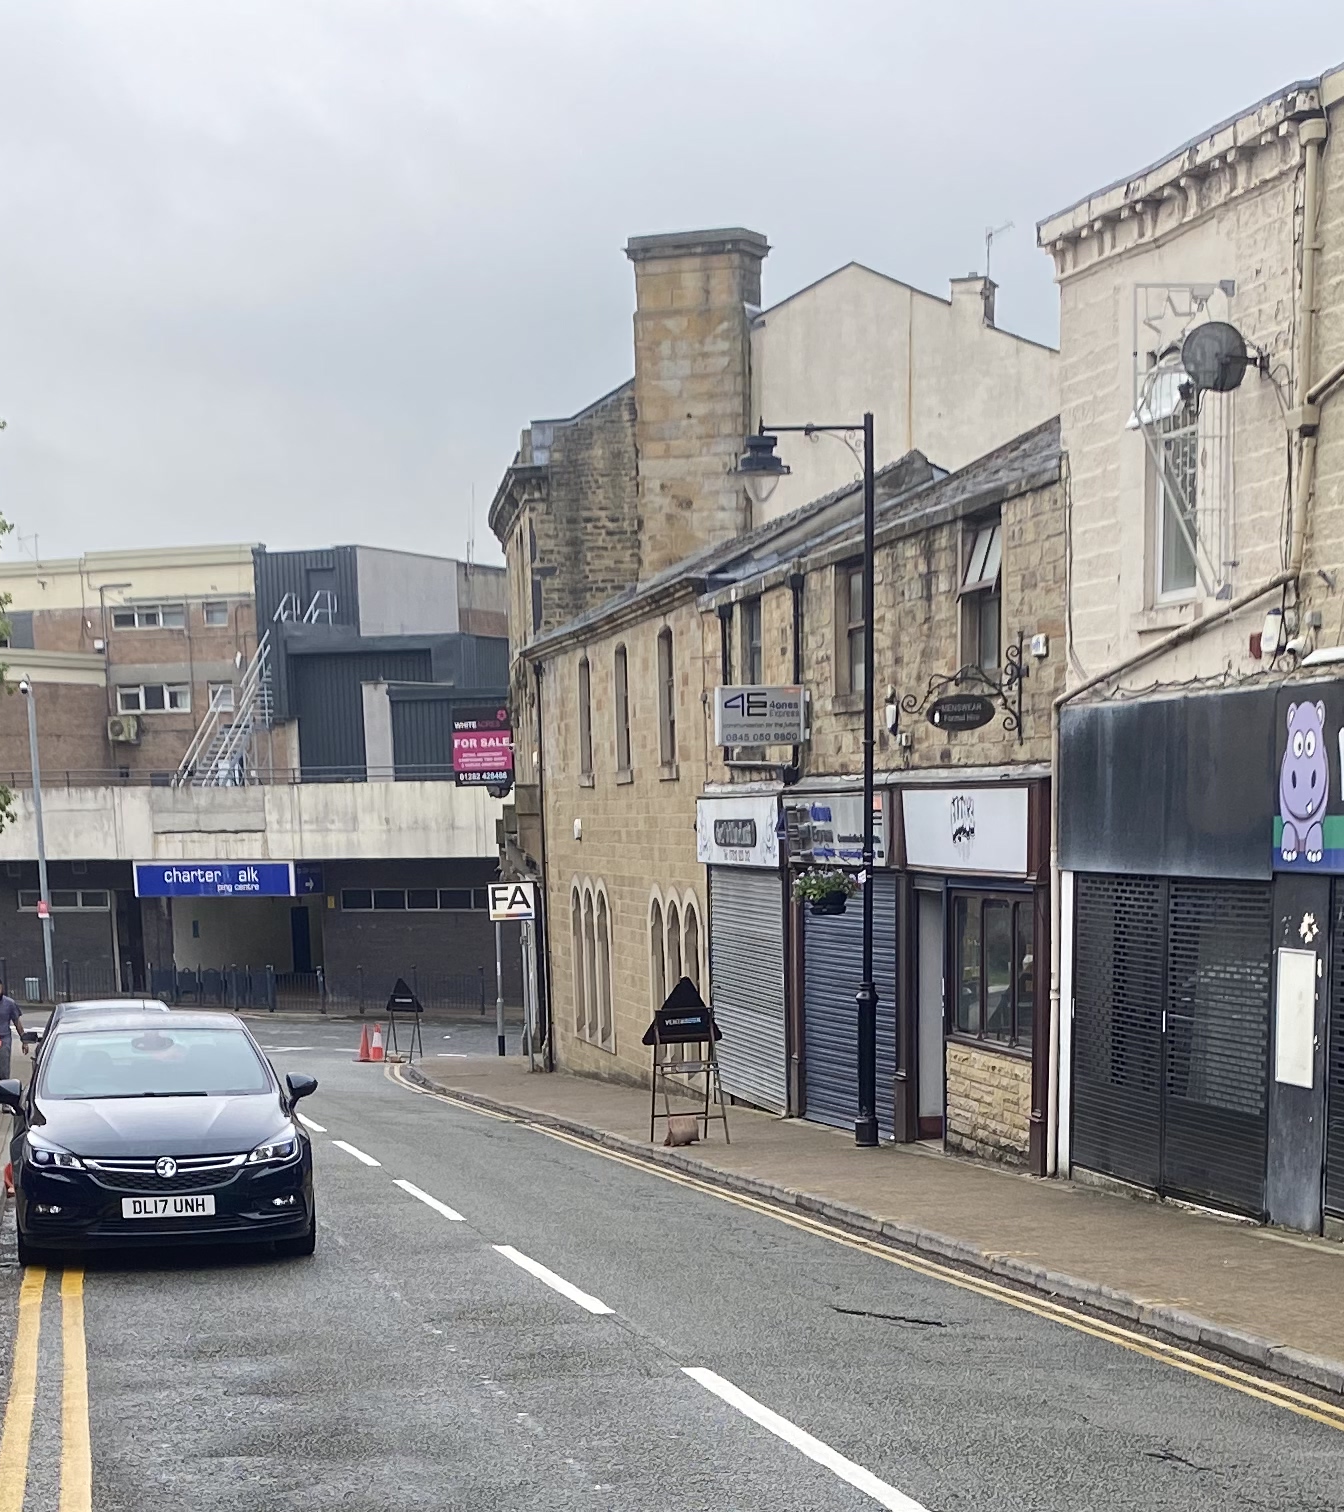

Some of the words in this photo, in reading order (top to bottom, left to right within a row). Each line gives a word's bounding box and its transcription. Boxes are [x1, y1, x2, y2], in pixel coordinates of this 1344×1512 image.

[454, 738, 477, 748] FOR
[480, 737, 510, 748] SALE
[164, 866, 222, 883] charter
[491, 885, 532, 910] FA
[132, 1199, 168, 1215] DL17
[174, 1197, 206, 1213] UNH
